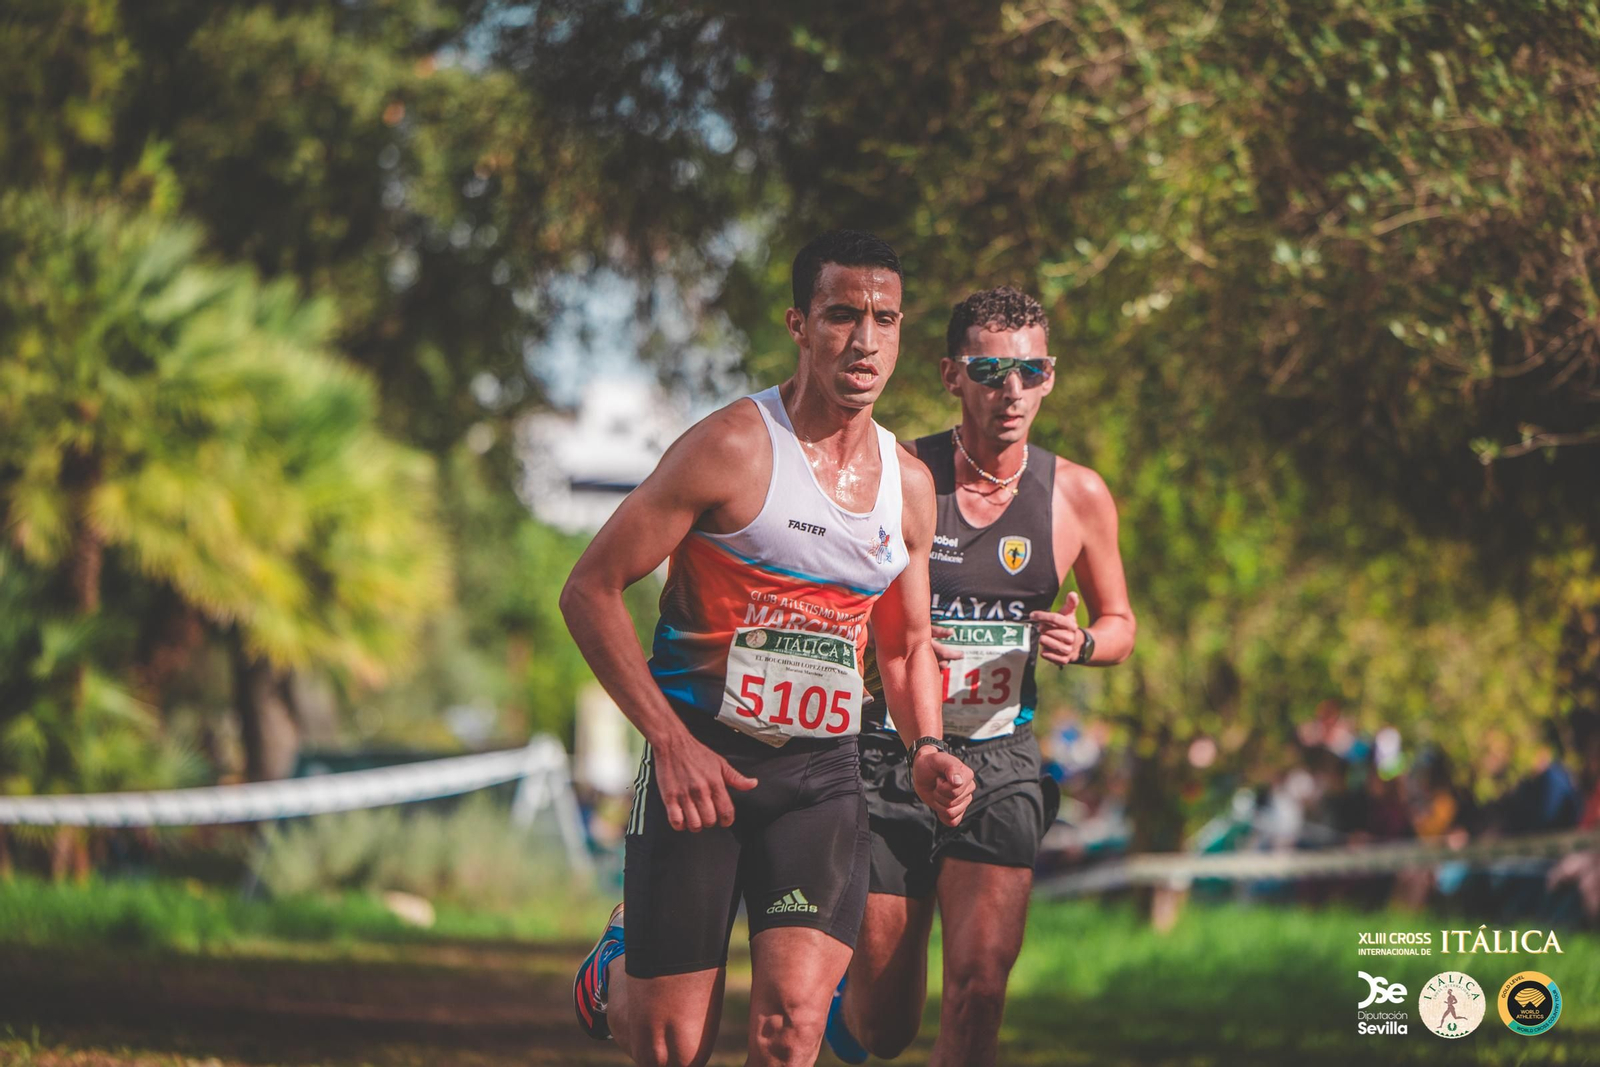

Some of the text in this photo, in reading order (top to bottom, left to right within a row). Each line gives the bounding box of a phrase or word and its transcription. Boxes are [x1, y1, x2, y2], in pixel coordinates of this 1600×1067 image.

[788, 519, 826, 537] FASTER
[751, 590, 777, 604] CLUB
[780, 597, 835, 619] ATLETISMO
[930, 594, 1025, 620] LAYAS
[946, 625, 994, 642] ÁLICA
[775, 635, 839, 659] ITÁLICA
[736, 674, 851, 734] 5105
[766, 902, 818, 914] adidas
